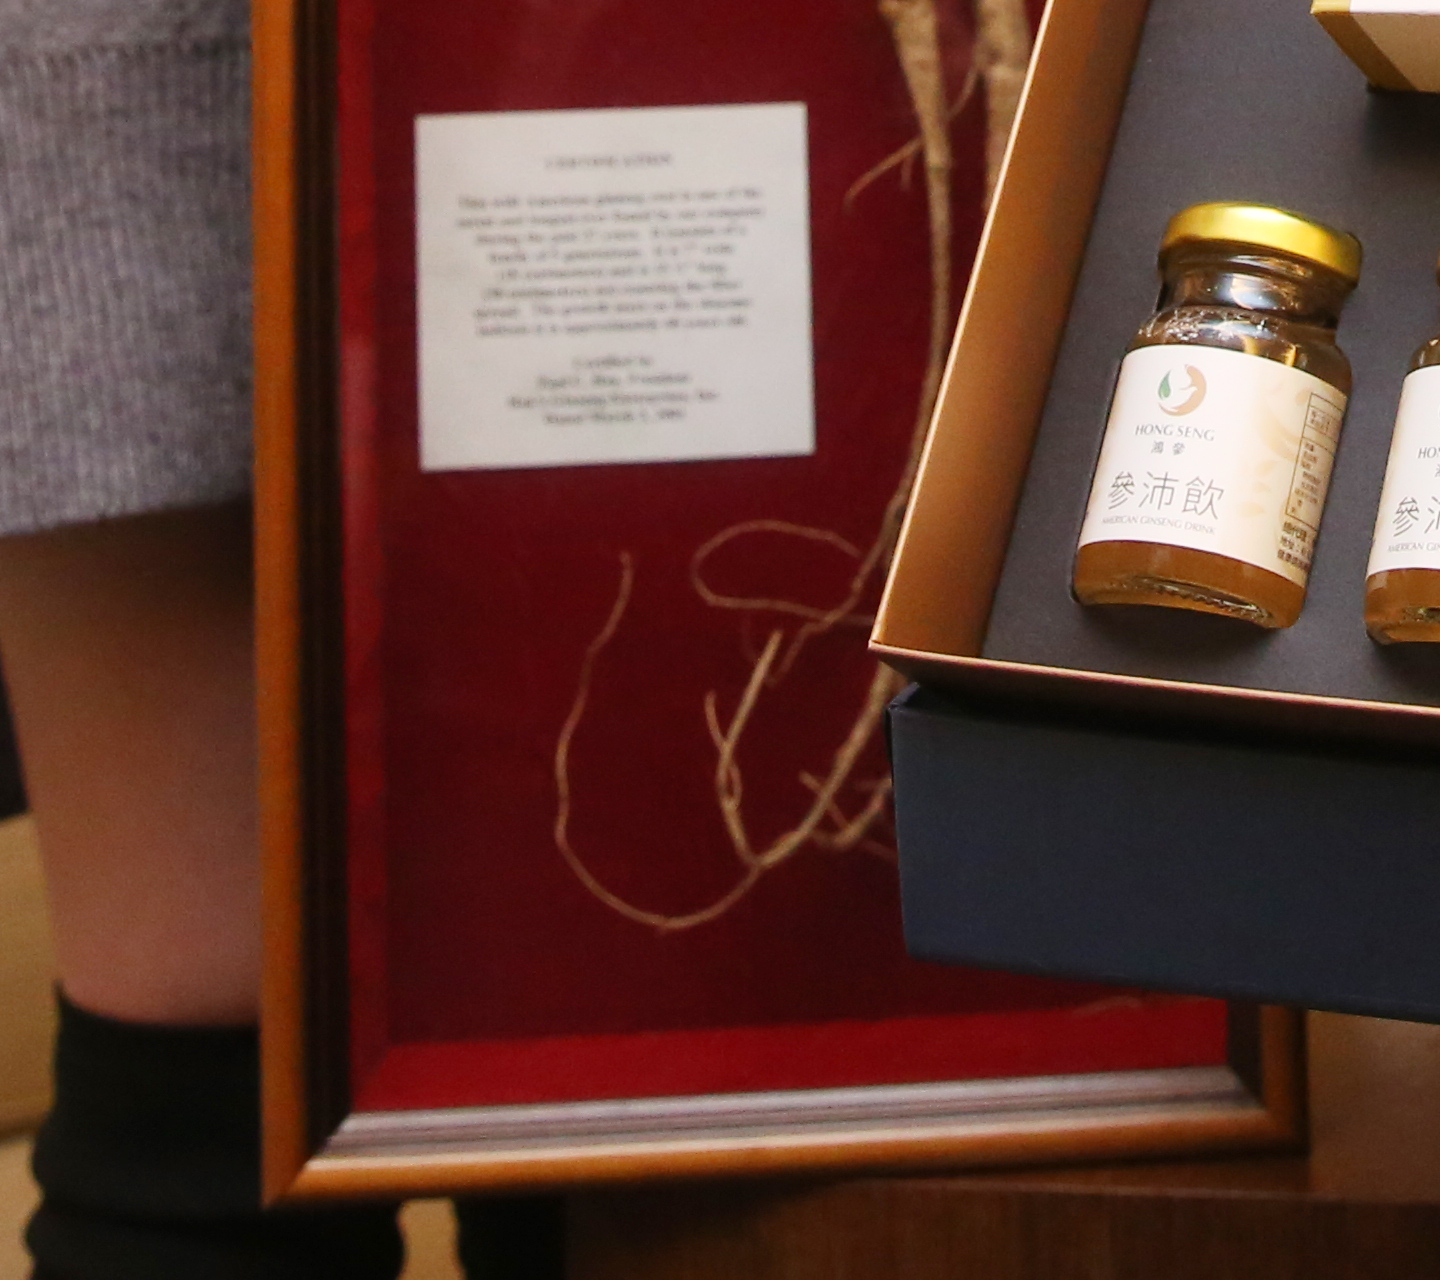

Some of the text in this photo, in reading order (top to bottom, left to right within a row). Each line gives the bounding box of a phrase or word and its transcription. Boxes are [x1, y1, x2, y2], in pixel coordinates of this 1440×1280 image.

[1134, 423, 1215, 442] HONG SENG
[1106, 470, 1225, 523] 參沛飲
[1386, 542, 1424, 553] AMERICAN
